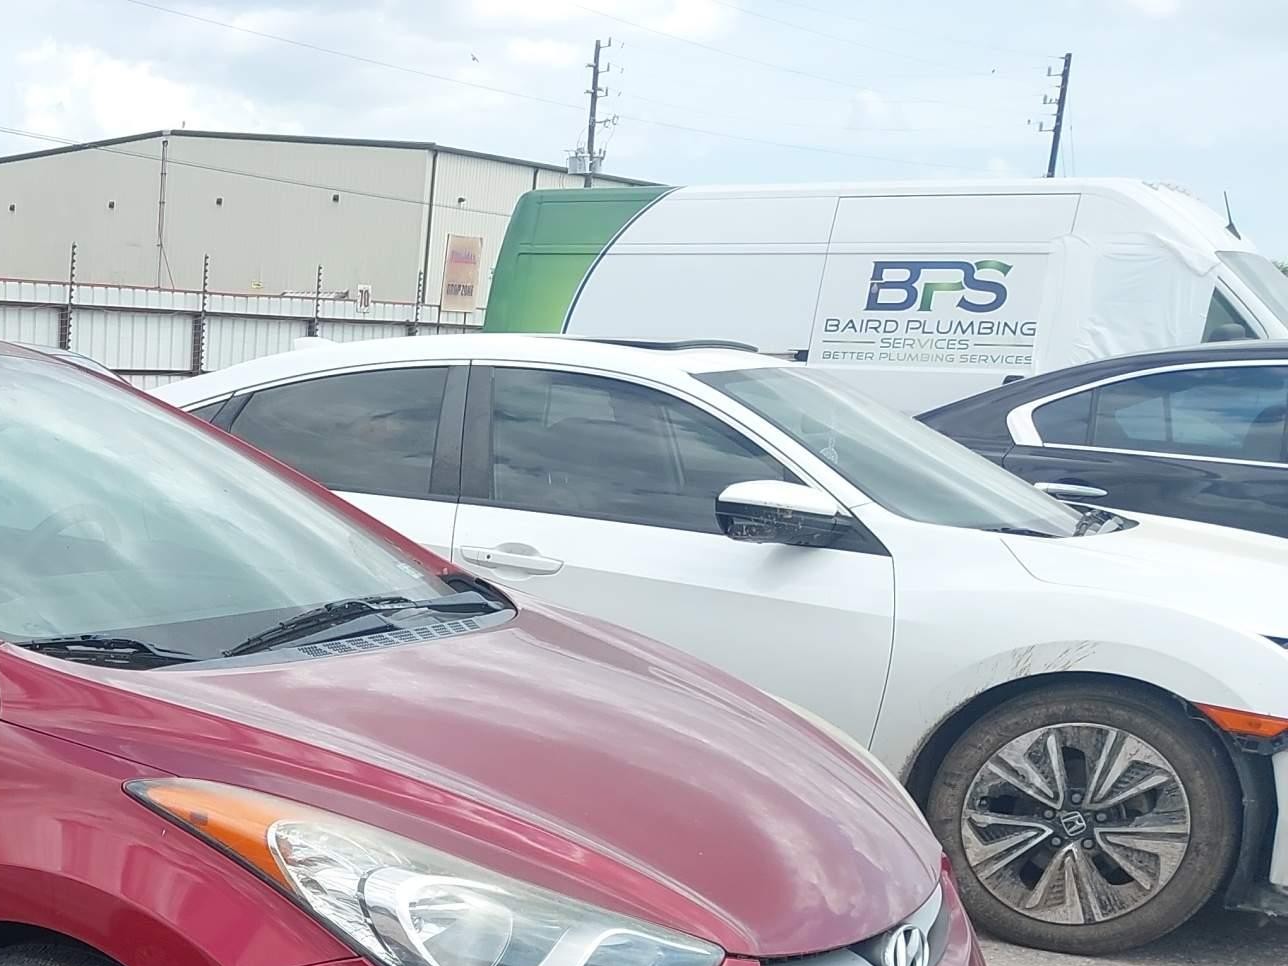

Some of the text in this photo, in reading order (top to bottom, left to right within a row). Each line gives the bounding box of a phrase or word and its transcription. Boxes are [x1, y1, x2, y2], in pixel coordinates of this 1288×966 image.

[863, 260, 1013, 313] BPS
[359, 289, 370, 308] 70
[823, 318, 1037, 337] BAIRD PLUMBING
[879, 337, 970, 350] SERVICES
[821, 350, 1033, 365] BETTER PLUMBING SERVICES
